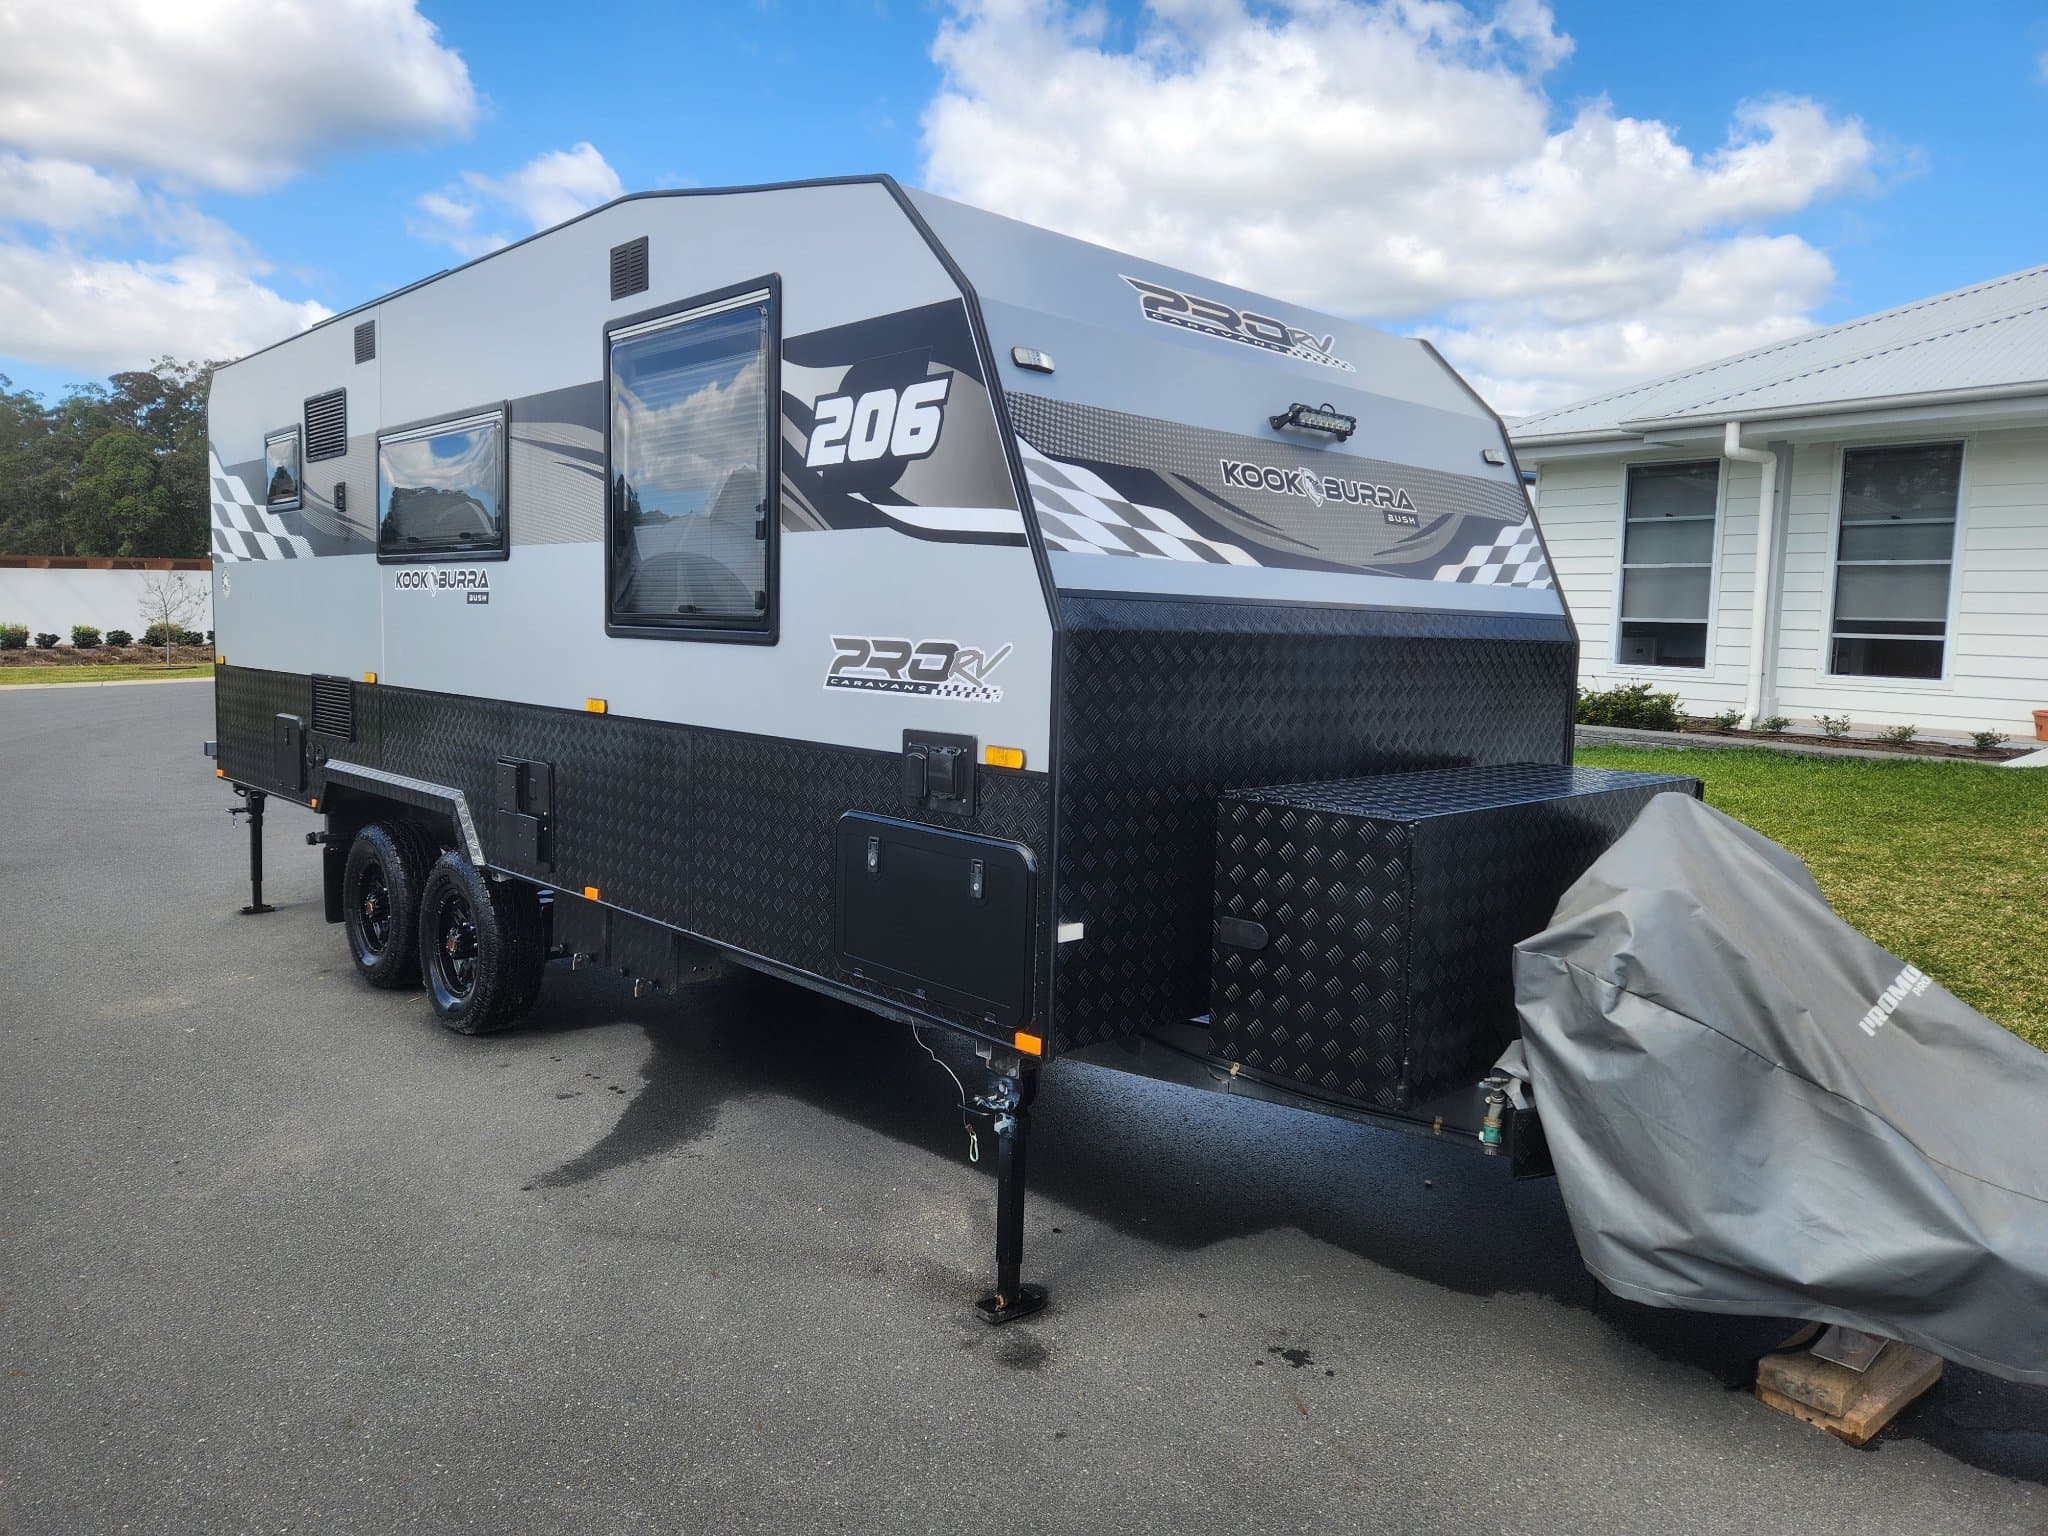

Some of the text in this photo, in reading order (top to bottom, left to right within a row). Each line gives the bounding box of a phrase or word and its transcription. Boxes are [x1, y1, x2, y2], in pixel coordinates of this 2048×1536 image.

[1151, 312, 1282, 352] CARAVANS
[806, 377, 950, 468] 206
[1387, 514, 1416, 525] BUSH
[468, 593, 488, 602] BUSH
[830, 635, 1014, 688] PRO RV
[830, 677, 929, 693] CARAVANS
[1911, 974, 1934, 997] PRO
